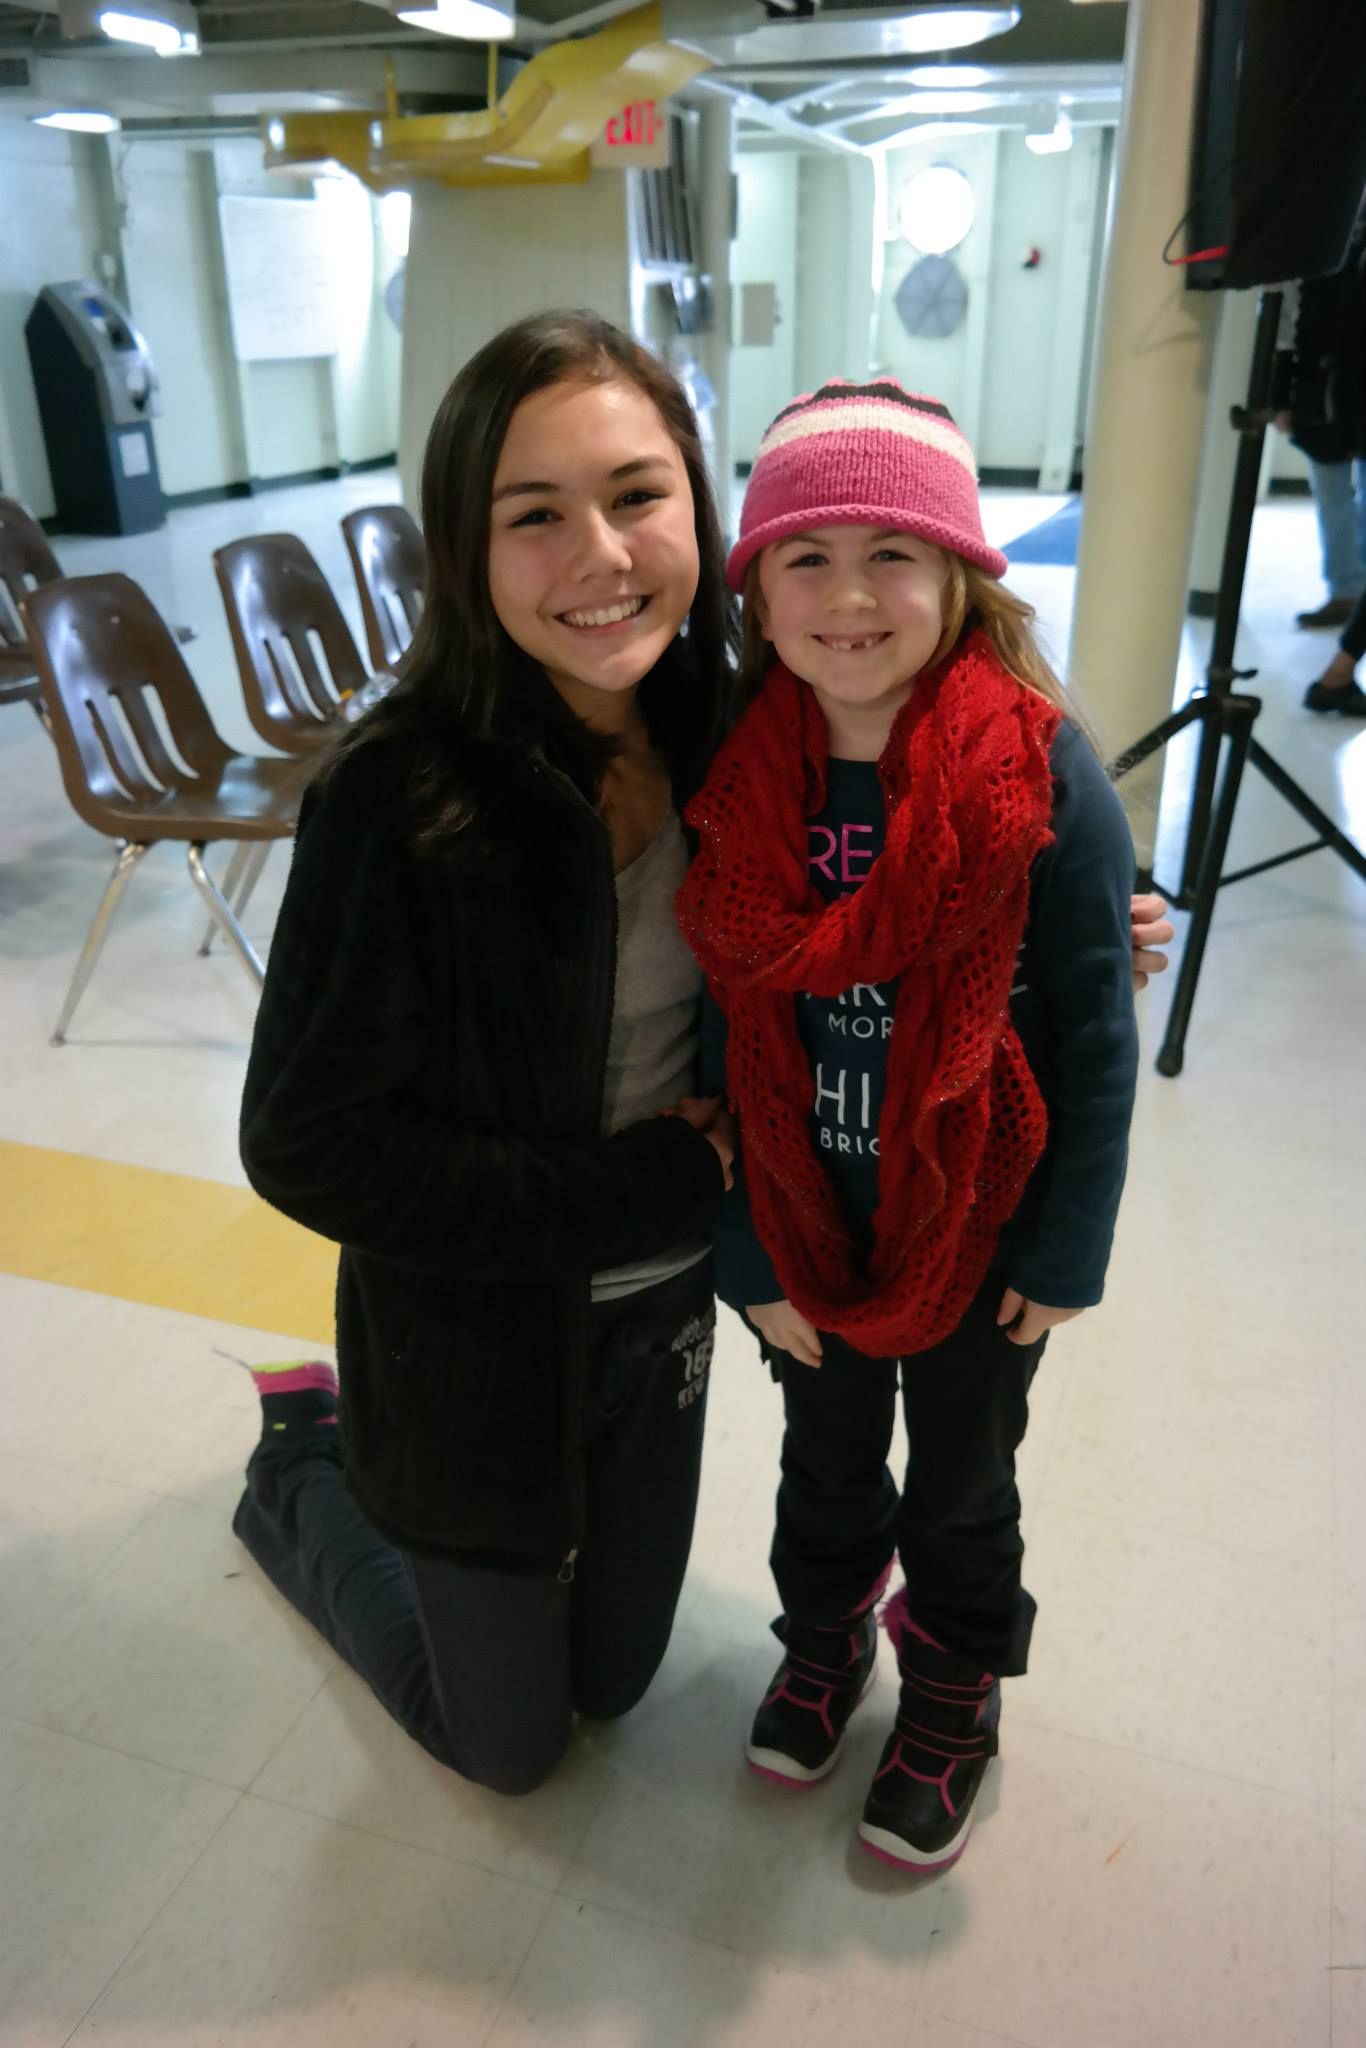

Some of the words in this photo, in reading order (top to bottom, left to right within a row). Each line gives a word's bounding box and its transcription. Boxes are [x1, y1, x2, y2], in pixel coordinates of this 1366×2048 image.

[605, 99, 657, 146] EXIT
[807, 823, 873, 882] RE
[828, 1012, 894, 1040] MOR
[815, 1063, 870, 1129] HI
